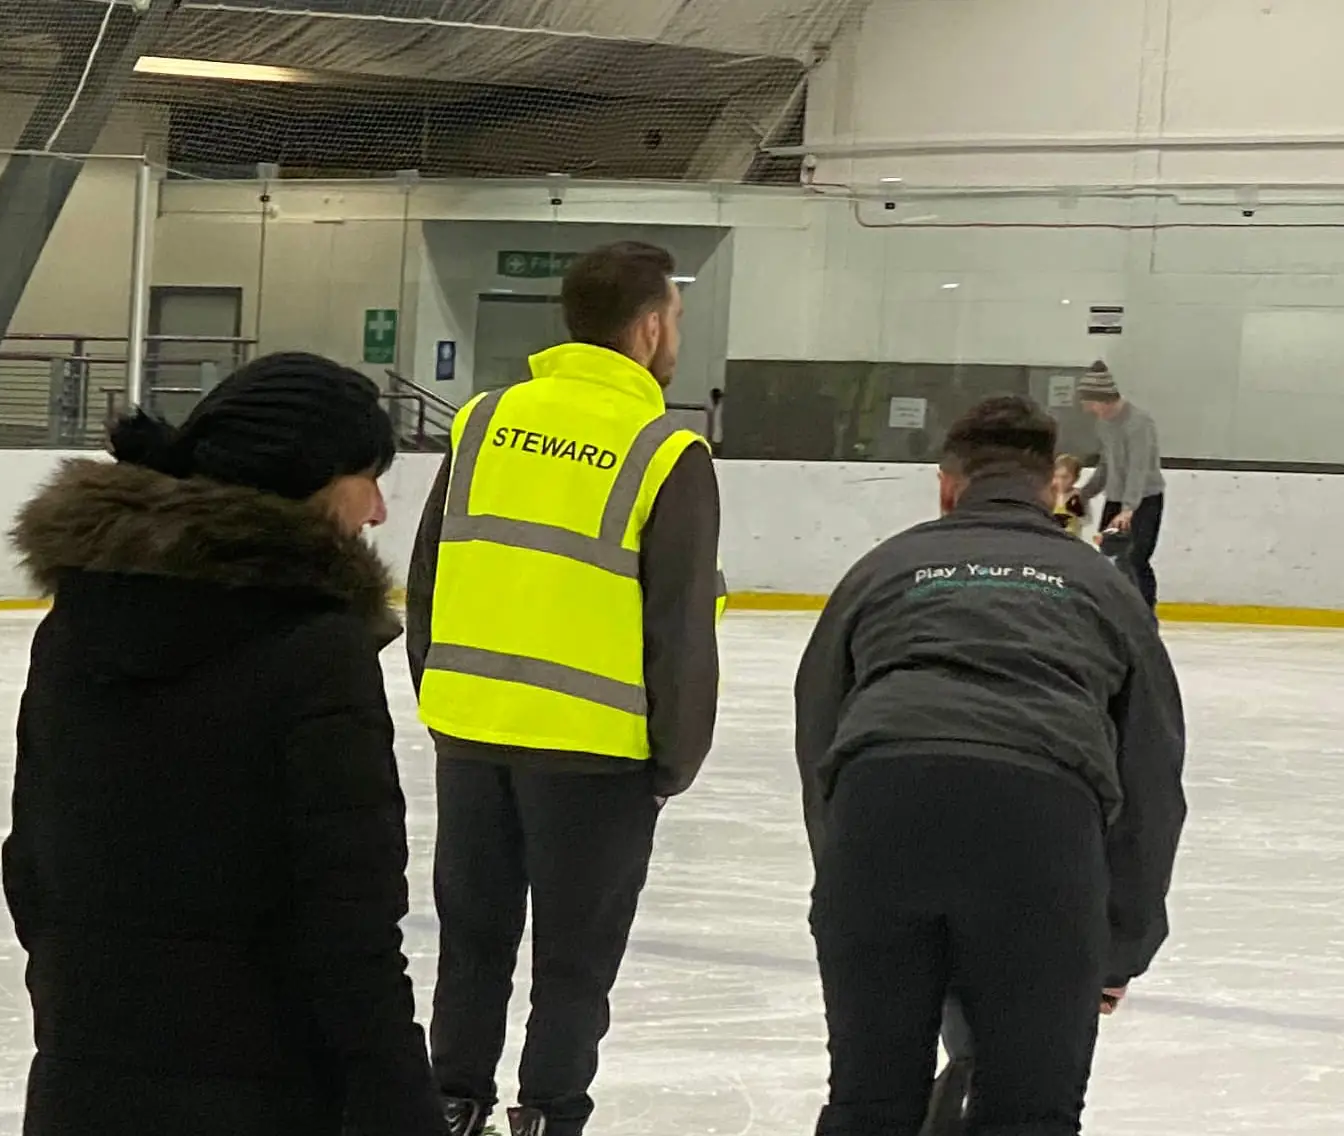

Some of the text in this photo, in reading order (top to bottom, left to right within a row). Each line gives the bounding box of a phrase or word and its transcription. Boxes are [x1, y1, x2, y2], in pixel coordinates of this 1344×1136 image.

[492, 427, 618, 471] STEWARD
[914, 564, 957, 584] Play
[966, 563, 1015, 578] Your
[1021, 565, 1065, 589] Part
